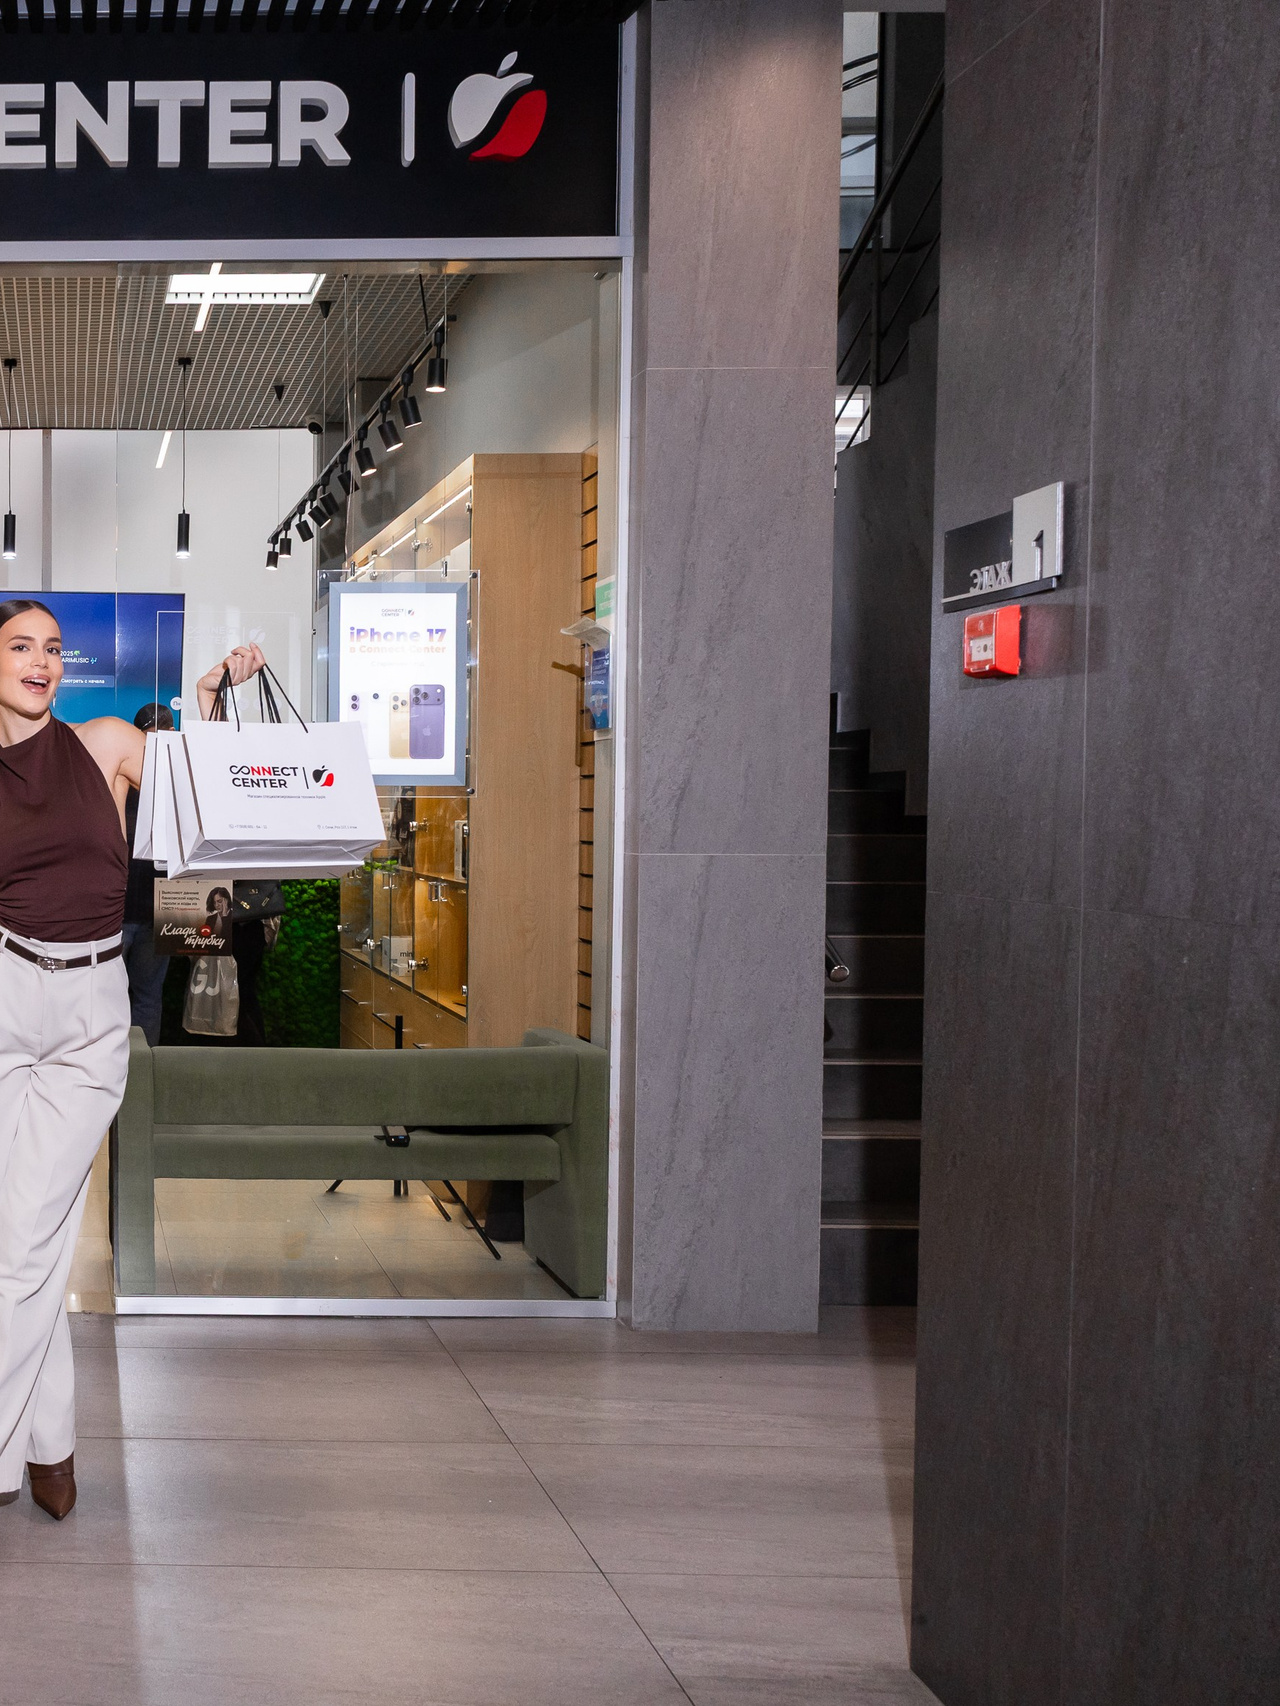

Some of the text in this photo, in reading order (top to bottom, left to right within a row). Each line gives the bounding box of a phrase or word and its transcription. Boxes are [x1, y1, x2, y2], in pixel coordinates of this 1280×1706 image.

[970, 529, 1044, 591] ЭТАЖ 1
[349, 626, 447, 642] iPhone 17
[359, 645, 405, 654] Connect
[409, 645, 447, 654] Center
[229, 765, 298, 776] CONNECT
[232, 777, 288, 789] CENTER
[160, 923, 197, 938] Клади
[184, 934, 226, 949] трубку
